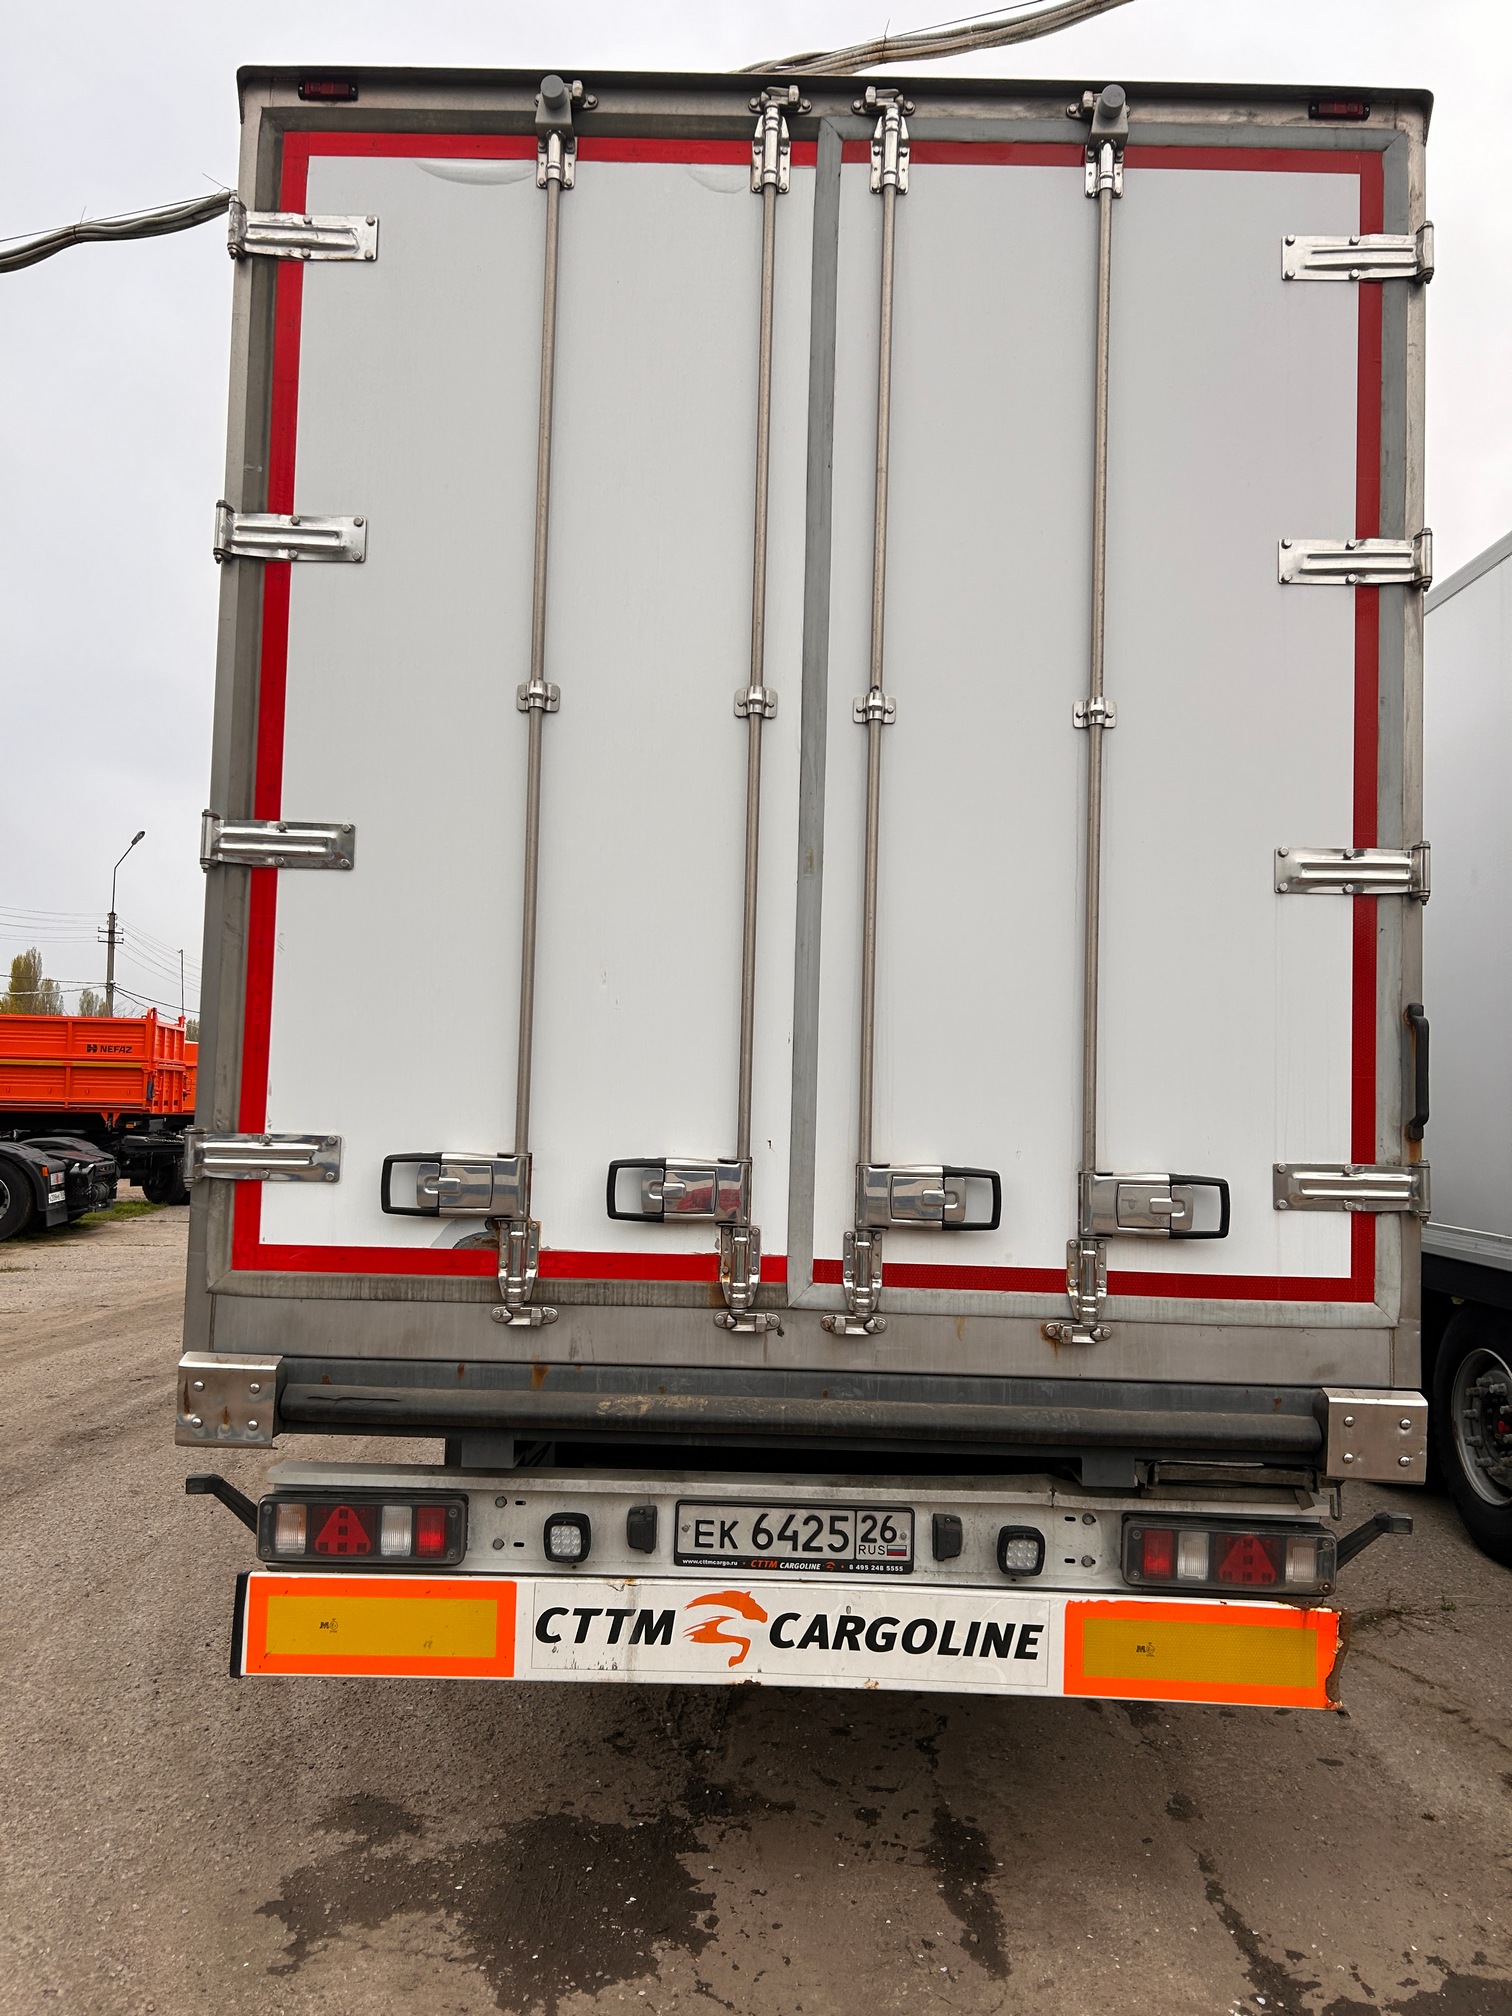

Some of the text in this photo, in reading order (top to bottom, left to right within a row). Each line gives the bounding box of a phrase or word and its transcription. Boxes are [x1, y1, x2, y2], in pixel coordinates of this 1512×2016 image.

[100, 1045, 133, 1054] NEFAZ
[751, 1513, 850, 1553] 6425
[860, 1515, 898, 1543] 26
[858, 1544, 886, 1556] RUS
[682, 1558, 738, 1567] www.cttmcargo.ru
[750, 1559, 778, 1569] CTTM
[779, 1562, 821, 1571] CARGOLINE
[870, 1564, 885, 1572] 248
[535, 1606, 1045, 1661] CTTM CARGOLINE
